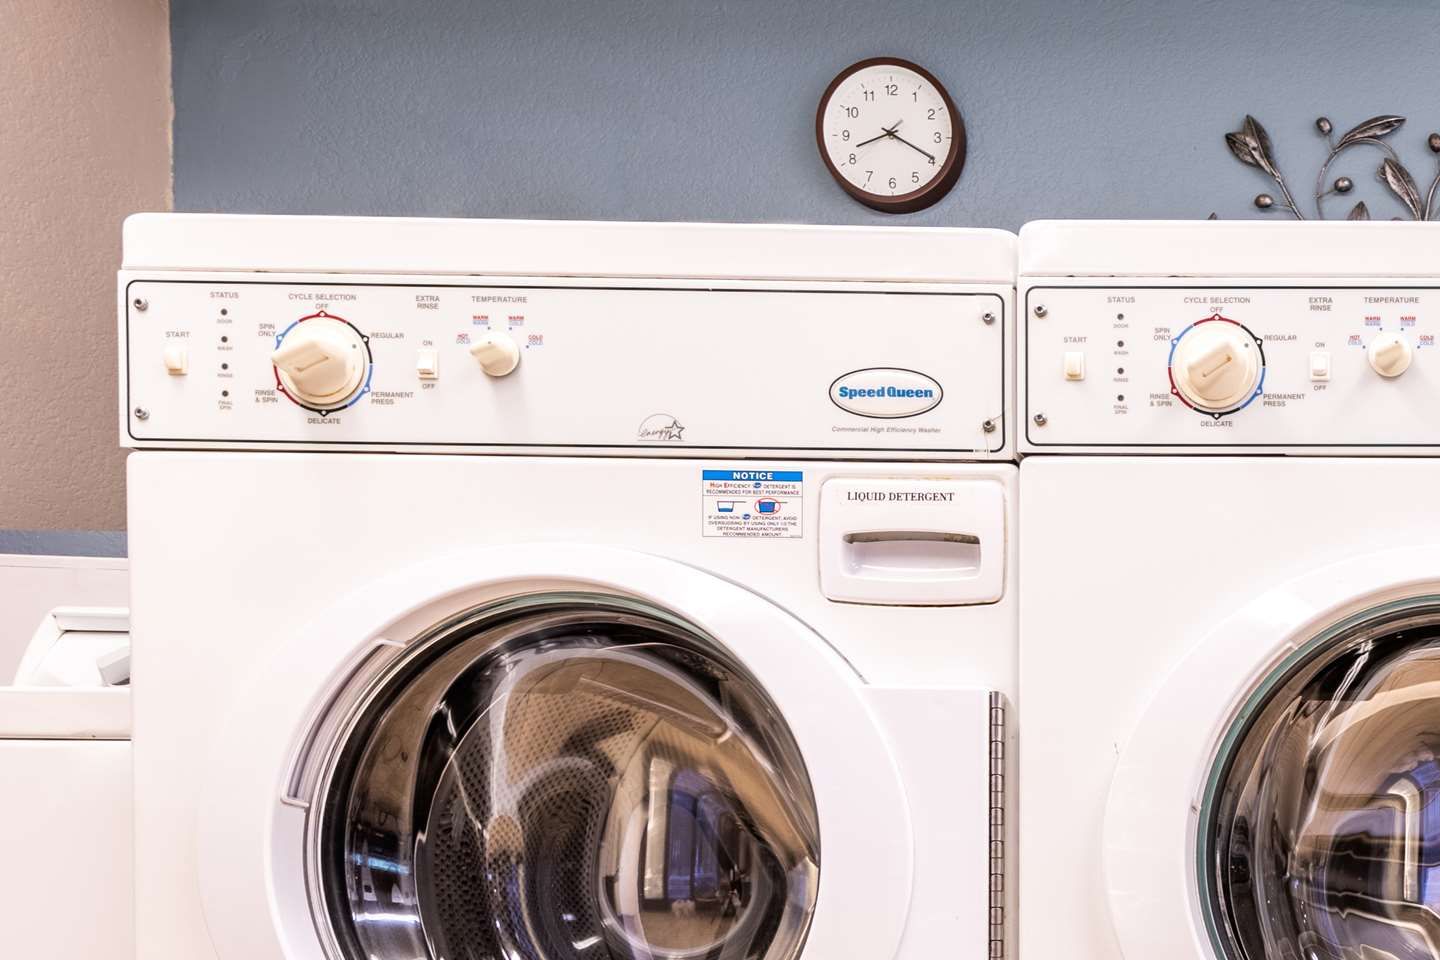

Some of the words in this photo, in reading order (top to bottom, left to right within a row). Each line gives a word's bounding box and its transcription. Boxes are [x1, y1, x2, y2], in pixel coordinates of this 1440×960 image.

[885, 84, 898, 96] 12
[863, 91, 875, 101] 11
[912, 92, 918, 102] 1
[845, 106, 859, 118] 10
[927, 109, 936, 121] 2
[842, 130, 850, 141] 9
[934, 132, 942, 144] 3
[849, 153, 857, 165] 8
[865, 170, 874, 182] 7
[912, 171, 920, 183] 5
[888, 177, 897, 189] 6
[210, 291, 239, 299] STATUS
[315, 293, 357, 301] SELECTION
[471, 295, 528, 303] TEMPERATURE
[1107, 296, 1135, 304] STATUS
[1183, 296, 1208, 304] CYCLE
[1210, 296, 1251, 304] SELECTION
[1364, 296, 1420, 304] TEMPERATURE
[839, 386, 885, 399] Speed
[887, 386, 933, 398] Queen
[307, 417, 341, 425] DELICATE
[870, 426, 885, 434] High
[886, 426, 917, 435] Efficiency
[732, 472, 773, 480] NOTICE
[847, 491, 886, 502] LIQUID
[888, 492, 954, 502] DETERGENT
